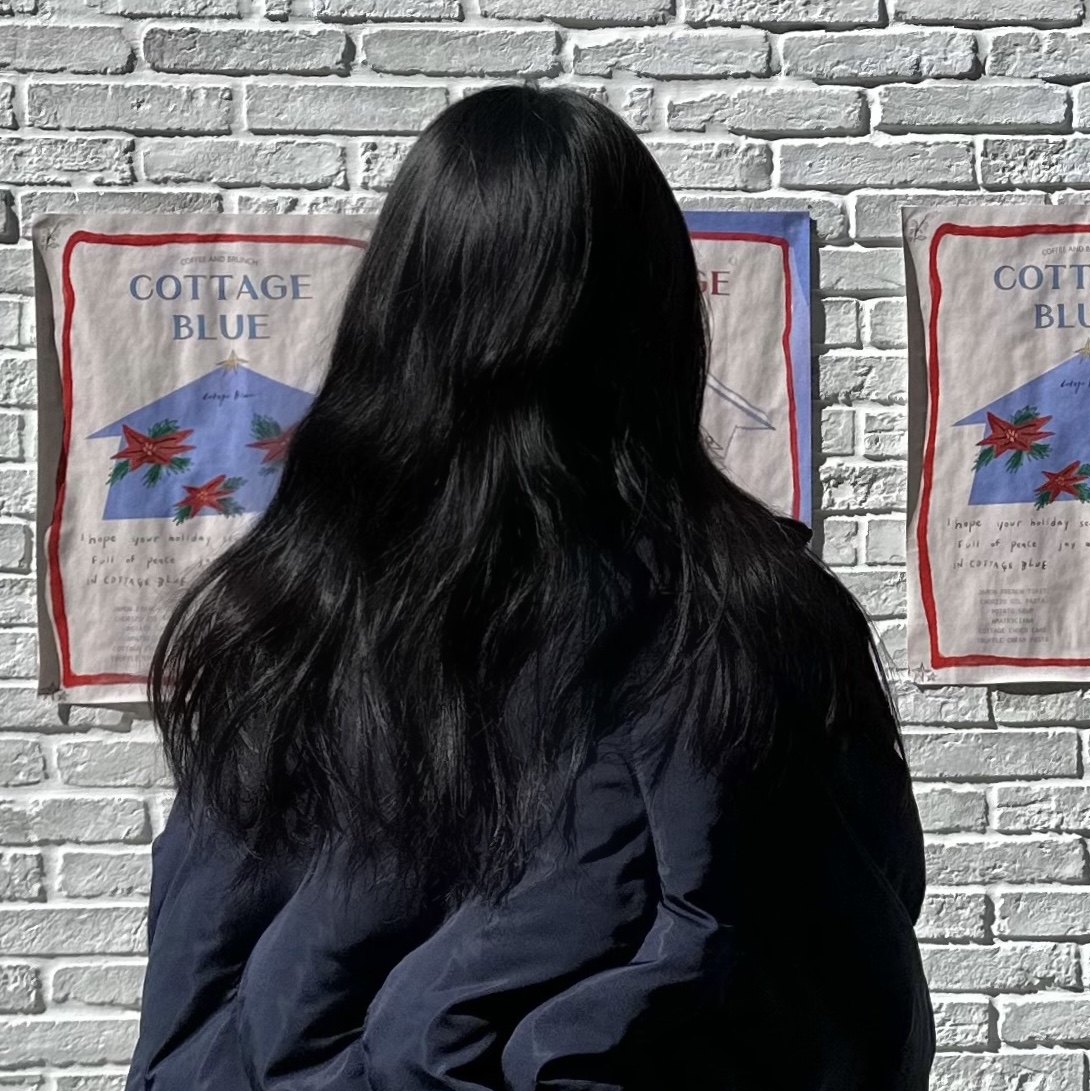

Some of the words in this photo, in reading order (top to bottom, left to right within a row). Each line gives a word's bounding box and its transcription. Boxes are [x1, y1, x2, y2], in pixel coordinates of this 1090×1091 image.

[1042, 247, 1066, 256] COFFEE
[130, 274, 313, 300] COTTAGE
[173, 315, 270, 340] BLUE
[955, 519, 981, 532] hope
[997, 520, 1023, 530] your
[1030, 518, 1069, 531] holiday
[132, 535, 160, 546] your
[990, 538, 1001, 547] of
[1011, 540, 1037, 552] peace
[1058, 541, 1076, 551] joy
[126, 555, 135, 563] of
[147, 557, 175, 568] peace
[953, 558, 963, 570] IN
[970, 559, 1013, 572] COTTAGE
[1021, 561, 1048, 571] BLUE
